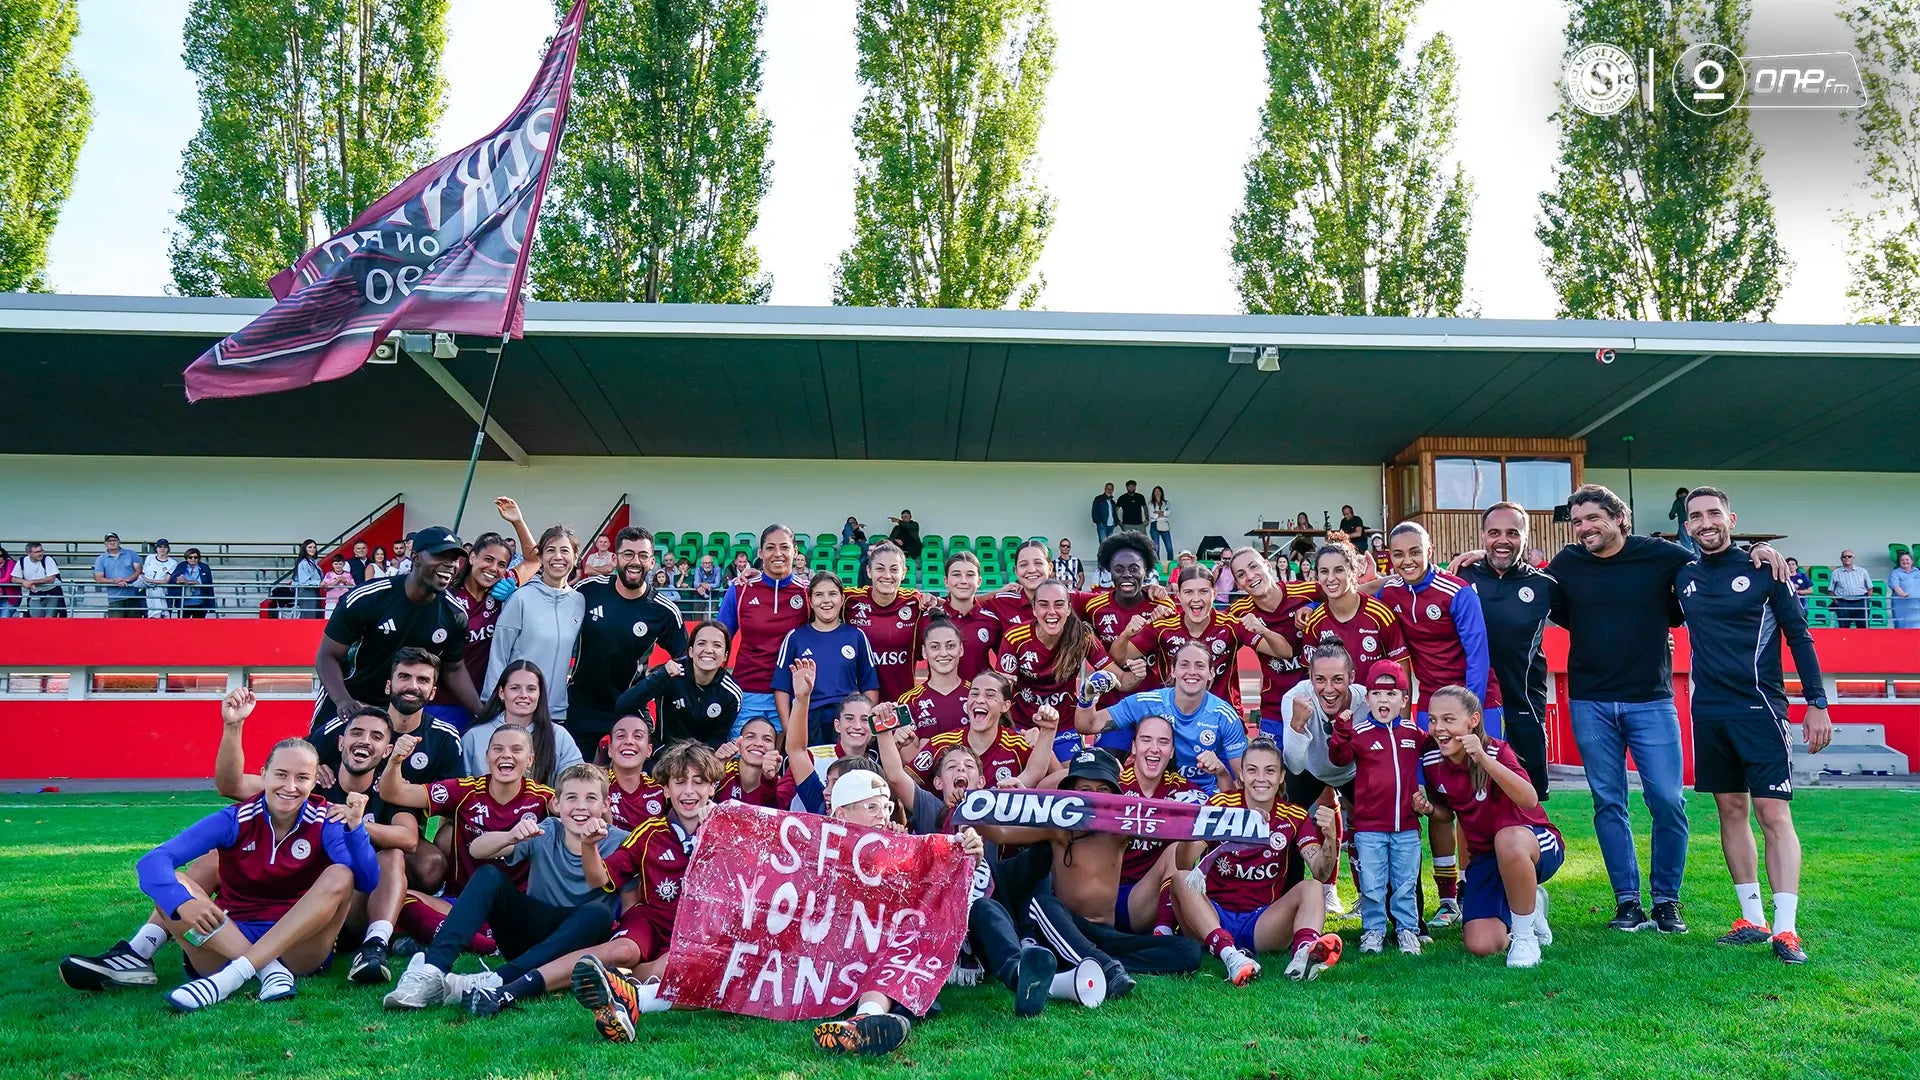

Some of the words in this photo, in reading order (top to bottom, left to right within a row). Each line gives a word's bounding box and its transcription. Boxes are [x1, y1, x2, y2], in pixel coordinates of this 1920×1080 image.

[872, 651, 908, 666] MSC
[961, 789, 1085, 828] OUNG
[1125, 805, 1136, 817] Y
[1144, 807, 1158, 818] F
[1120, 820, 1134, 831] 2
[1144, 821, 1158, 834] 5
[770, 815, 891, 887] SFC
[1235, 862, 1280, 881] MSC
[736, 873, 927, 954] YOUNG
[717, 941, 869, 1007] FANS
